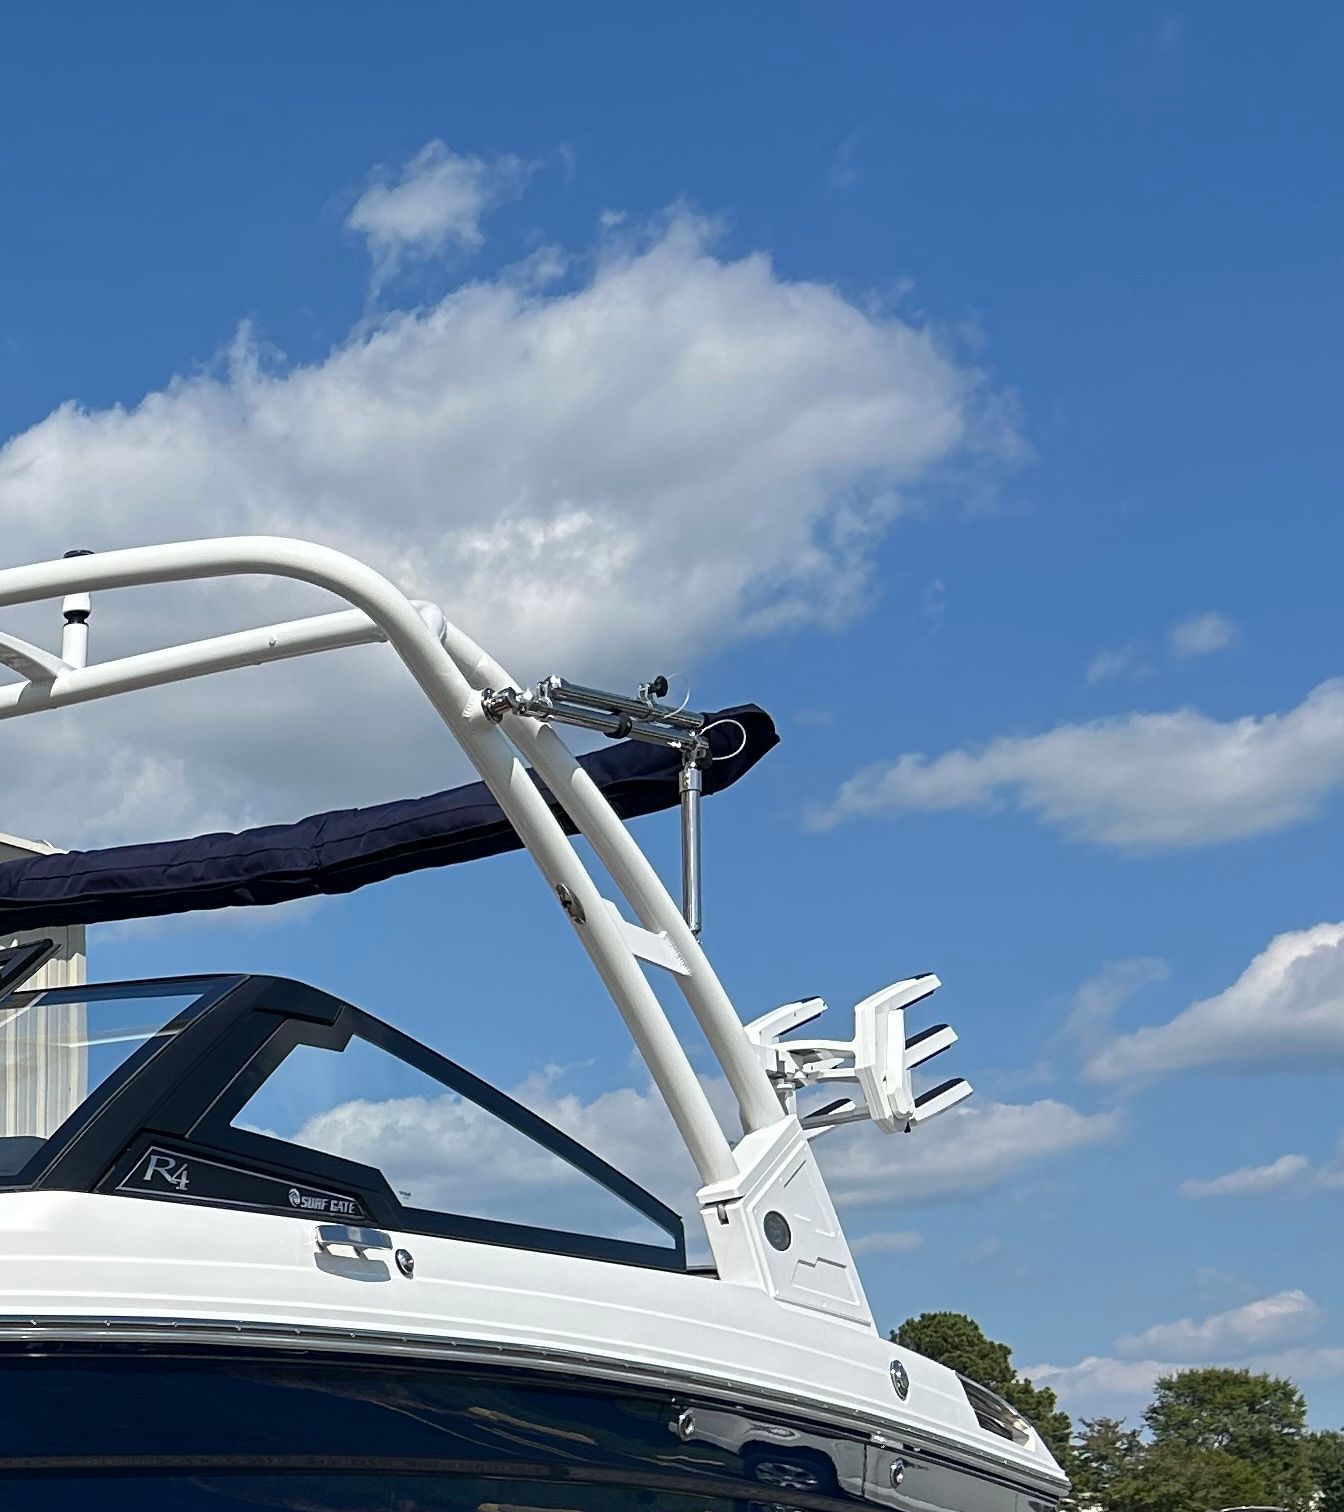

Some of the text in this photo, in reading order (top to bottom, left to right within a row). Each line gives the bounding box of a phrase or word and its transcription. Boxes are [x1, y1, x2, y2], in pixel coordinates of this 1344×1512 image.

[142, 1154, 191, 1191] R4
[300, 1195, 357, 1214] SURF GATE
